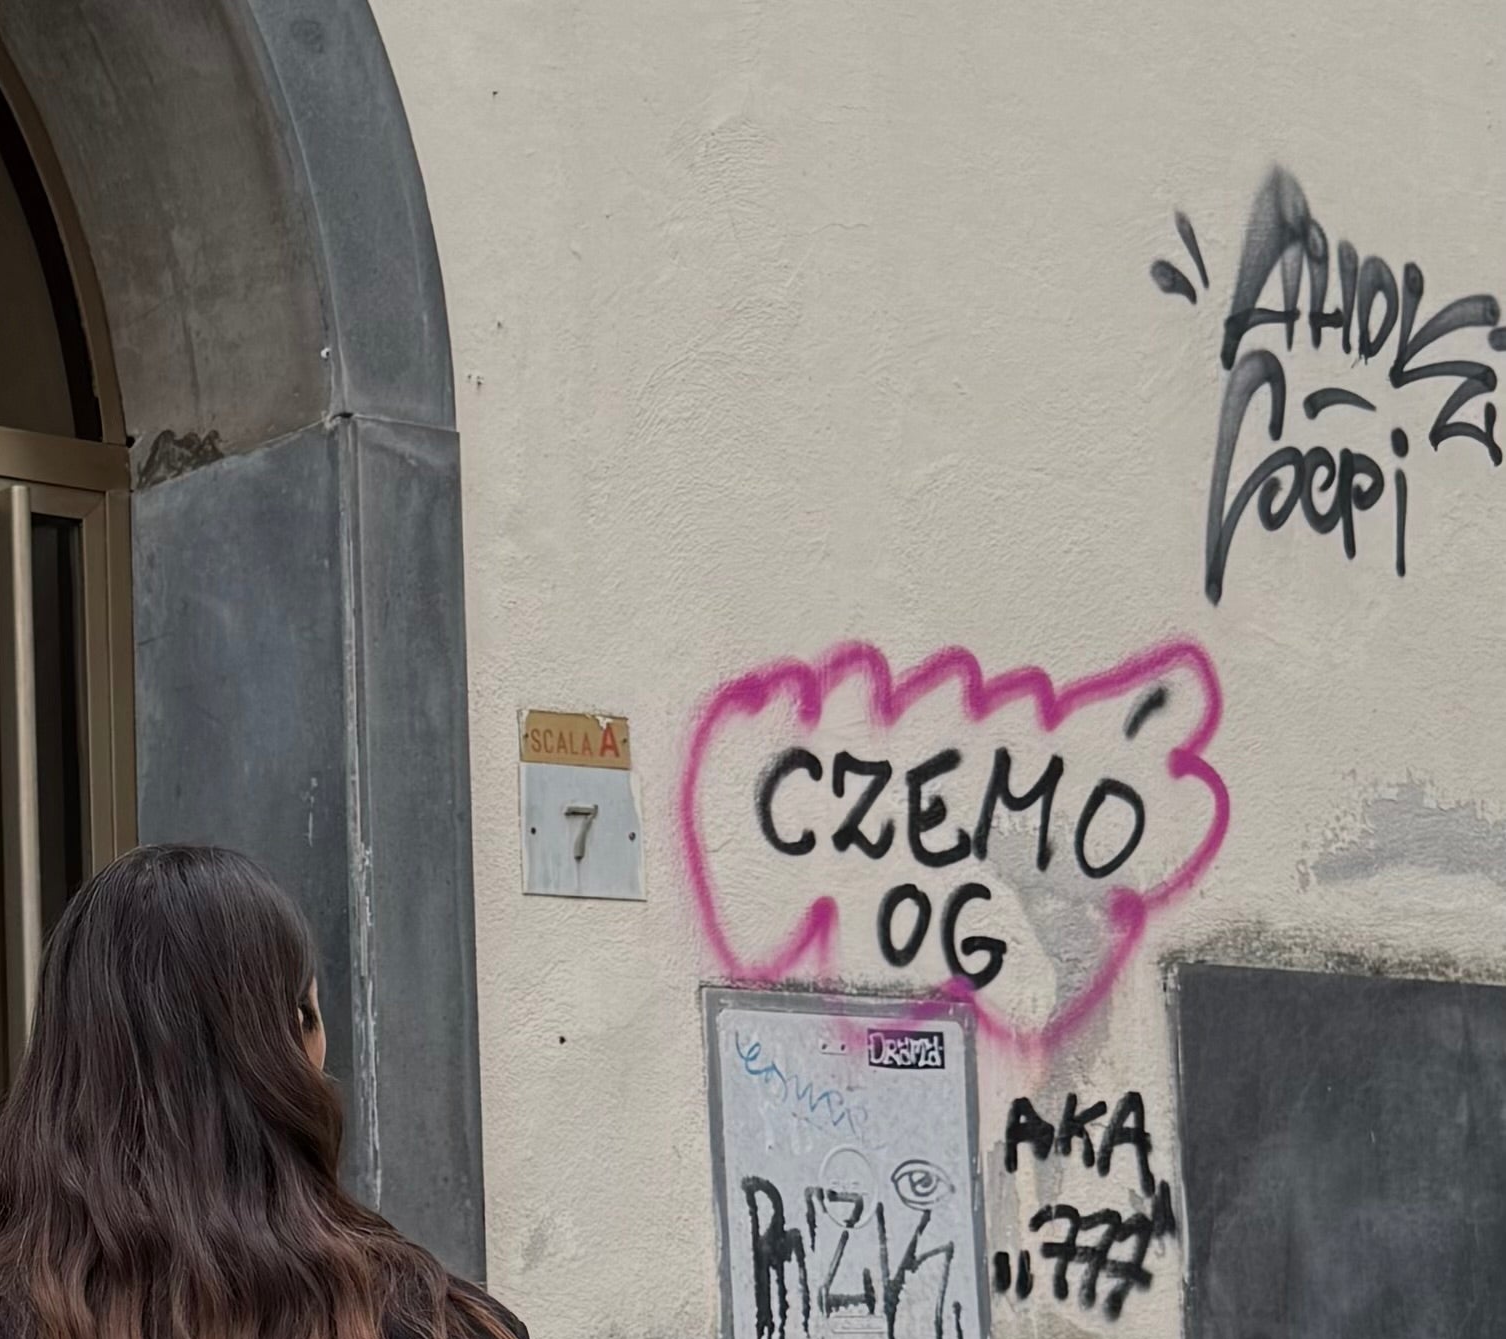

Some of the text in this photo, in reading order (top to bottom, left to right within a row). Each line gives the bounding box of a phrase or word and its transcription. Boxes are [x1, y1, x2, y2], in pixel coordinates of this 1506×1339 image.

[530, 722, 621, 758] SCALA A
[564, 803, 599, 862] 7
[877, 883, 1006, 990] OG
[1004, 1091, 1156, 1197] AKA
